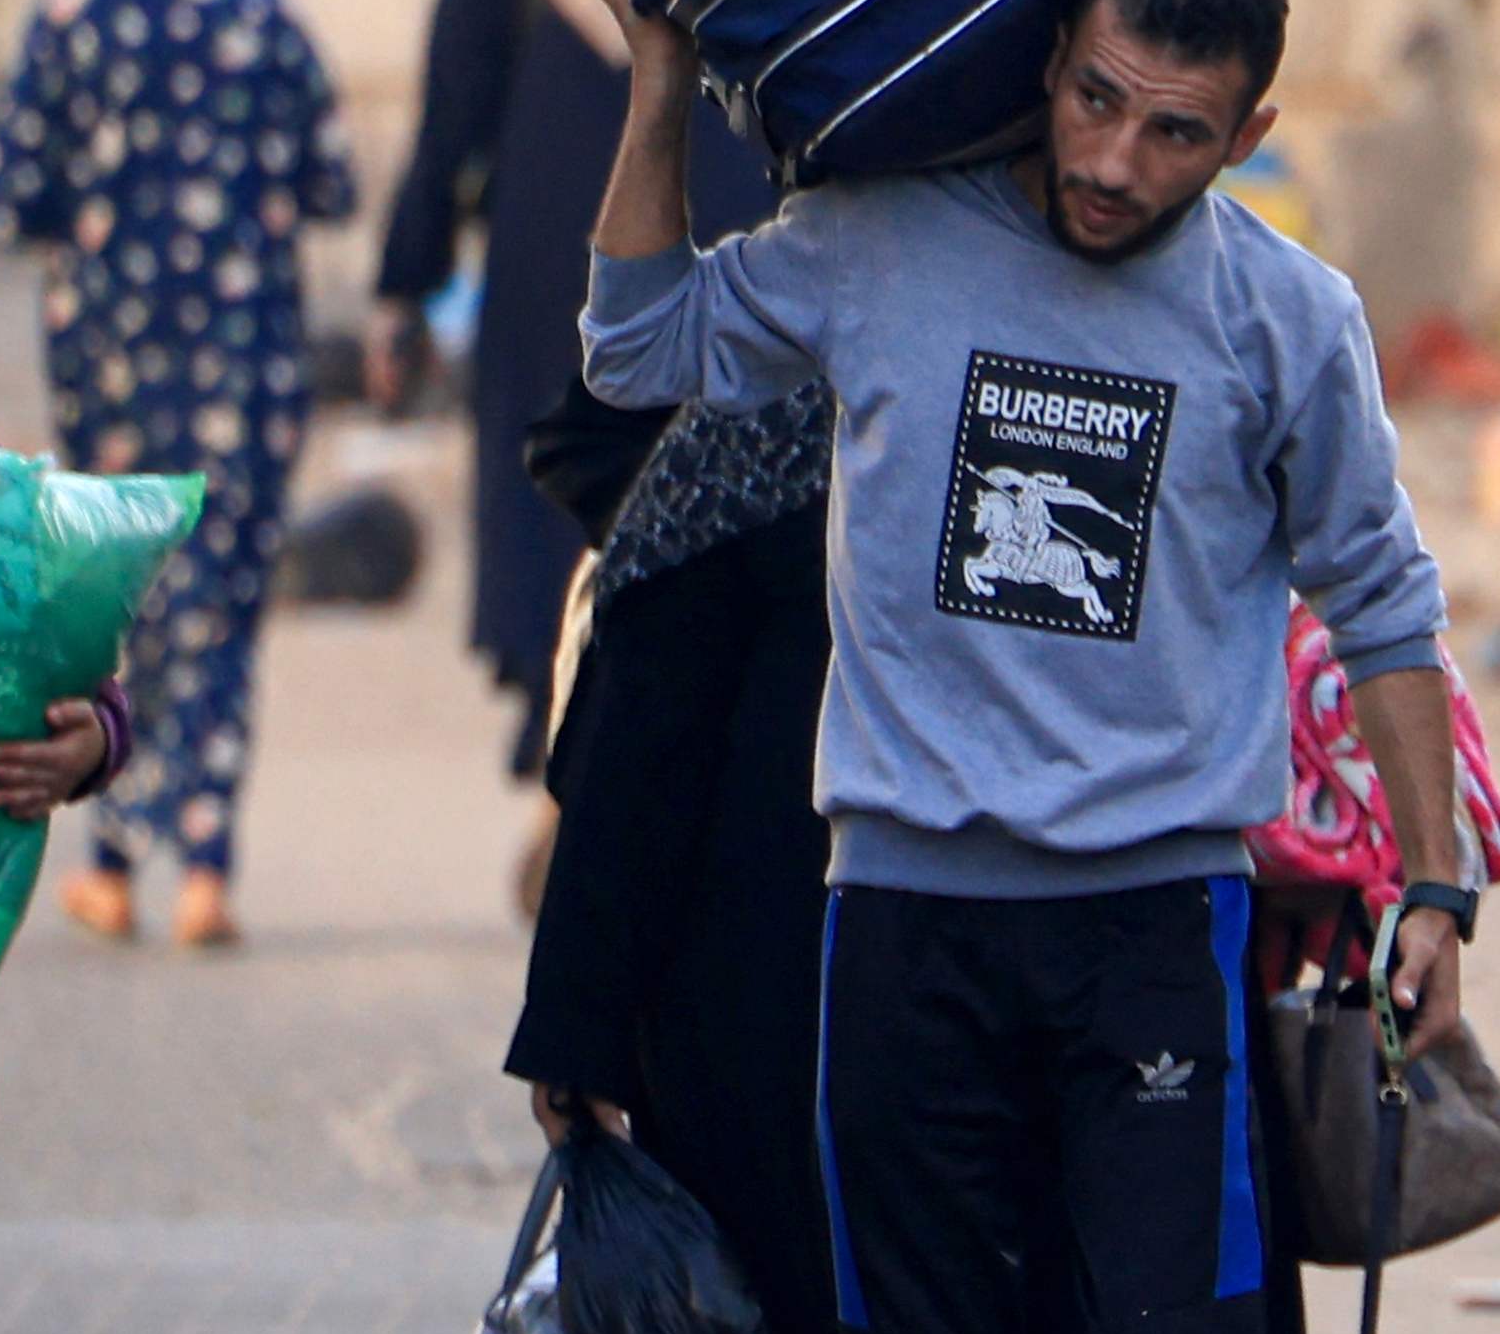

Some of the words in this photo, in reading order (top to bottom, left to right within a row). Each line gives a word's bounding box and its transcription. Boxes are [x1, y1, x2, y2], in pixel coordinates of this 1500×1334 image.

[978, 381, 1151, 441] BURBERRY
[990, 421, 1053, 448] LONDON
[1056, 433, 1128, 460] ENGLAND
